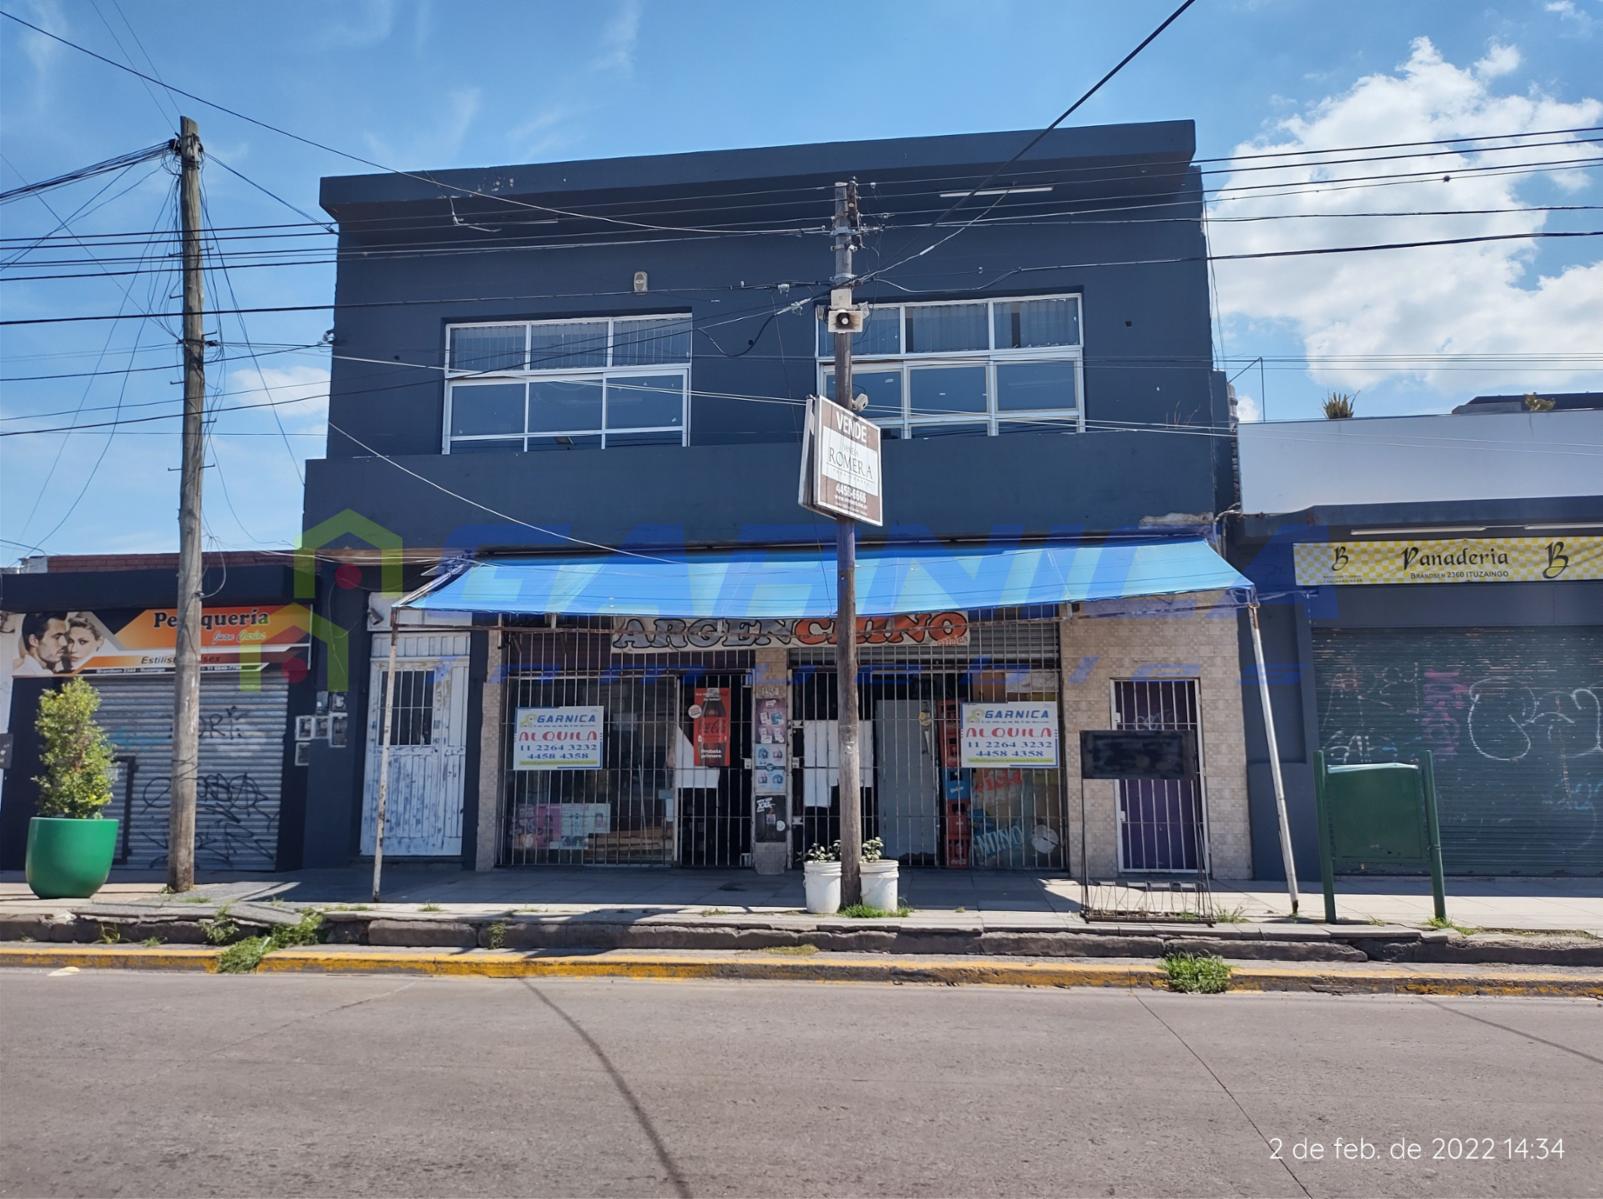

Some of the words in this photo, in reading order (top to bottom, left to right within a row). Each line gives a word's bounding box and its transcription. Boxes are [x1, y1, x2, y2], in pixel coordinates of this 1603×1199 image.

[836, 411, 867, 442] VENDE
[828, 447, 873, 479] ROMERA
[1401, 547, 1509, 570] Panaderia
[153, 609, 270, 630] Pequería
[141, 655, 177, 665] Estilist
[537, 714, 597, 723] GARNICA
[984, 709, 1049, 719] GARNICA
[519, 731, 598, 741] ALQUILA
[967, 728, 1052, 738] ALQUILA
[527, 752, 556, 760] 4458
[560, 752, 589, 760] 4358
